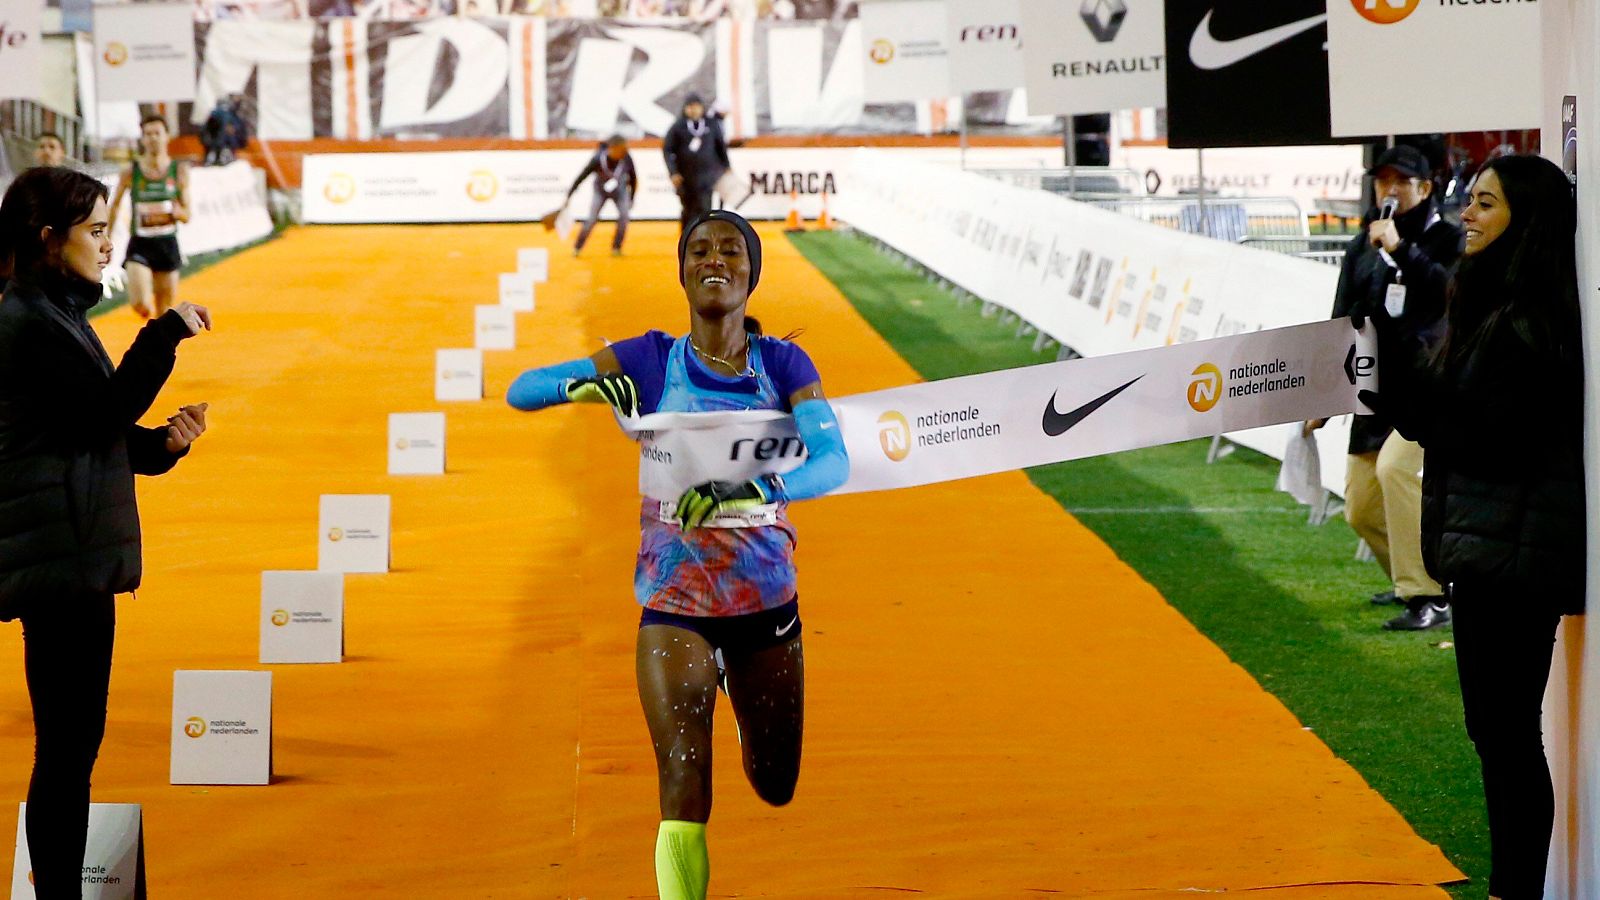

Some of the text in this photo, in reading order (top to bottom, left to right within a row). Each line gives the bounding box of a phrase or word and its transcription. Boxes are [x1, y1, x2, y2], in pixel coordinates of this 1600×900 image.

[1052, 55, 1163, 77] RENAULT
[750, 172, 837, 195] MARCA
[1230, 359, 1287, 381] nationale
[1229, 375, 1306, 399] nederlanden
[917, 405, 980, 429] nationale
[918, 421, 1001, 448] nederlanden
[209, 719, 247, 727] nationale
